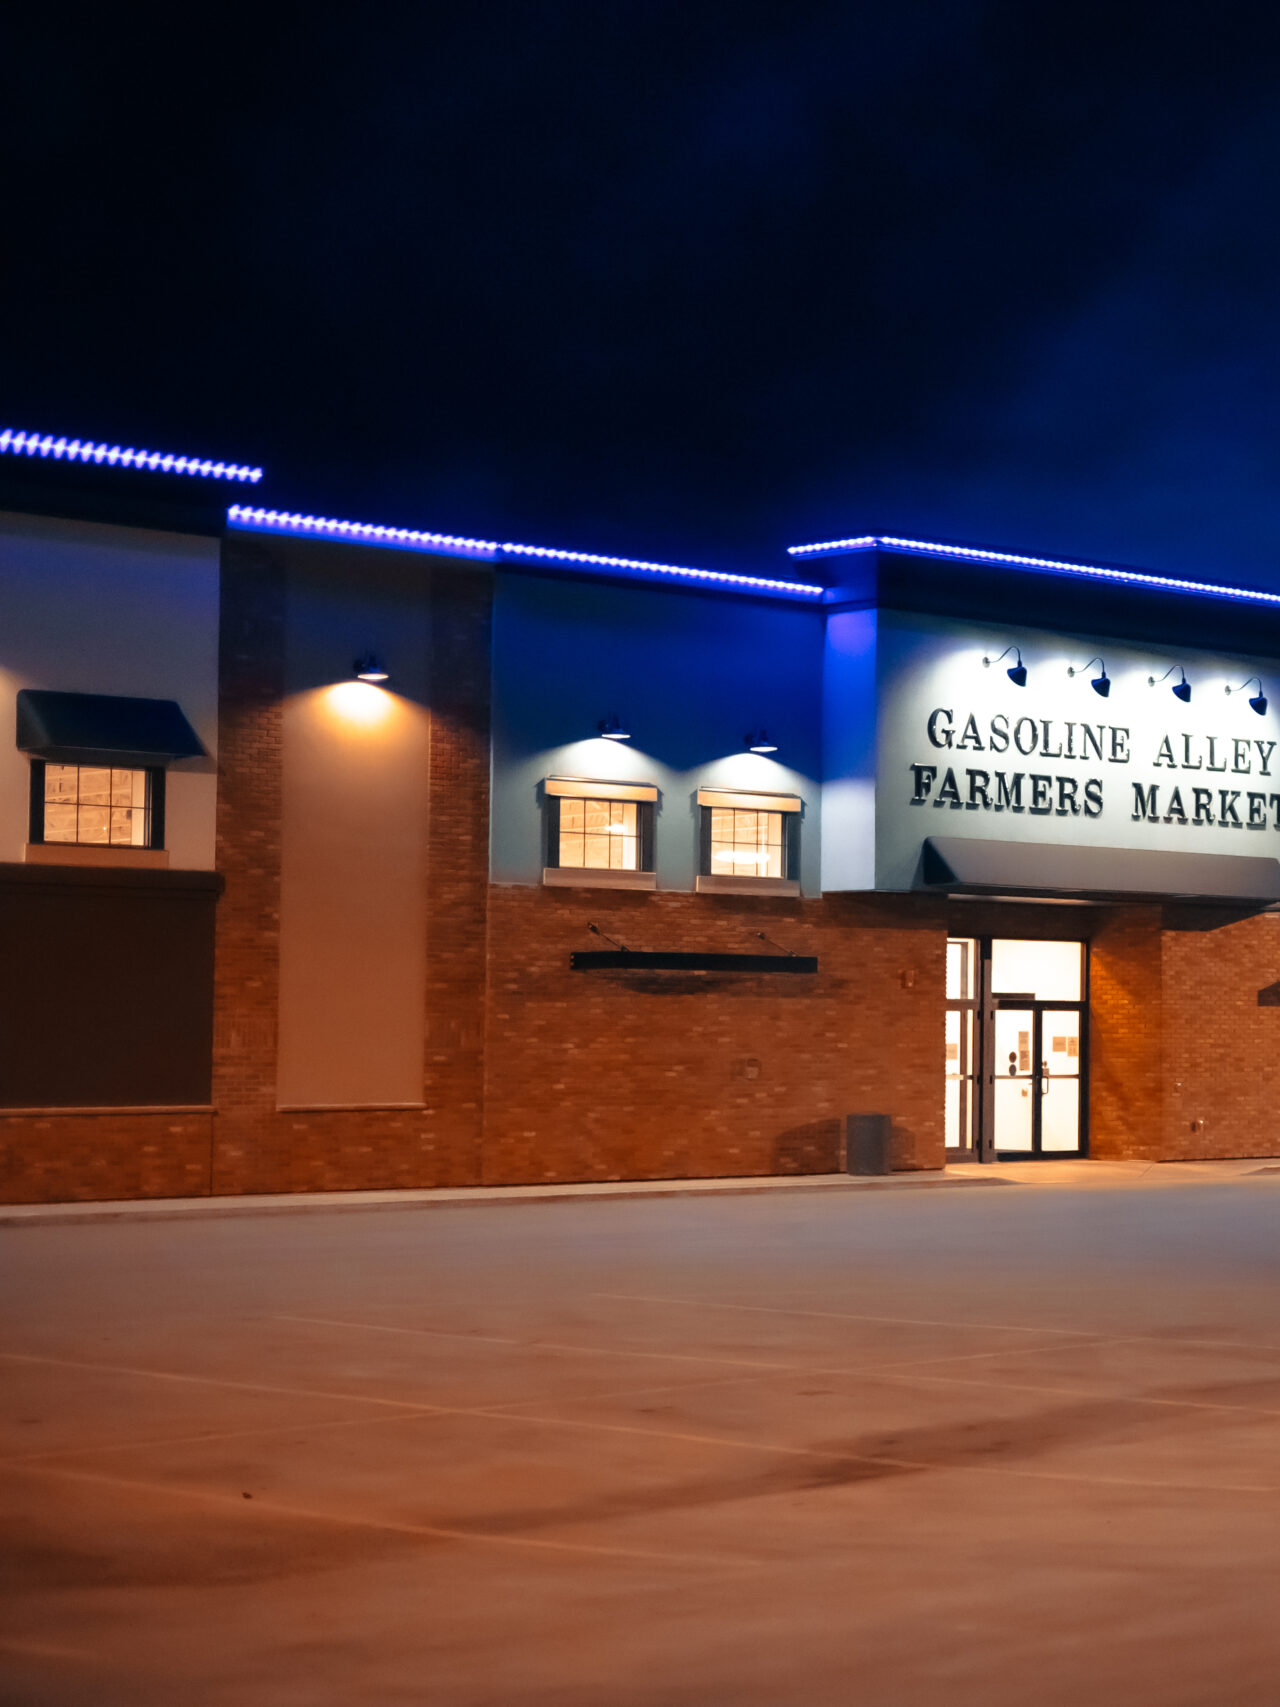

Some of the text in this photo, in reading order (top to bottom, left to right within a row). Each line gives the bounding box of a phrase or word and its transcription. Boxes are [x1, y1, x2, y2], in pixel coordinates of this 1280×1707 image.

[927, 708, 1277, 776] GASOLINE ALLEY
[909, 762, 1104, 817] FARMERS
